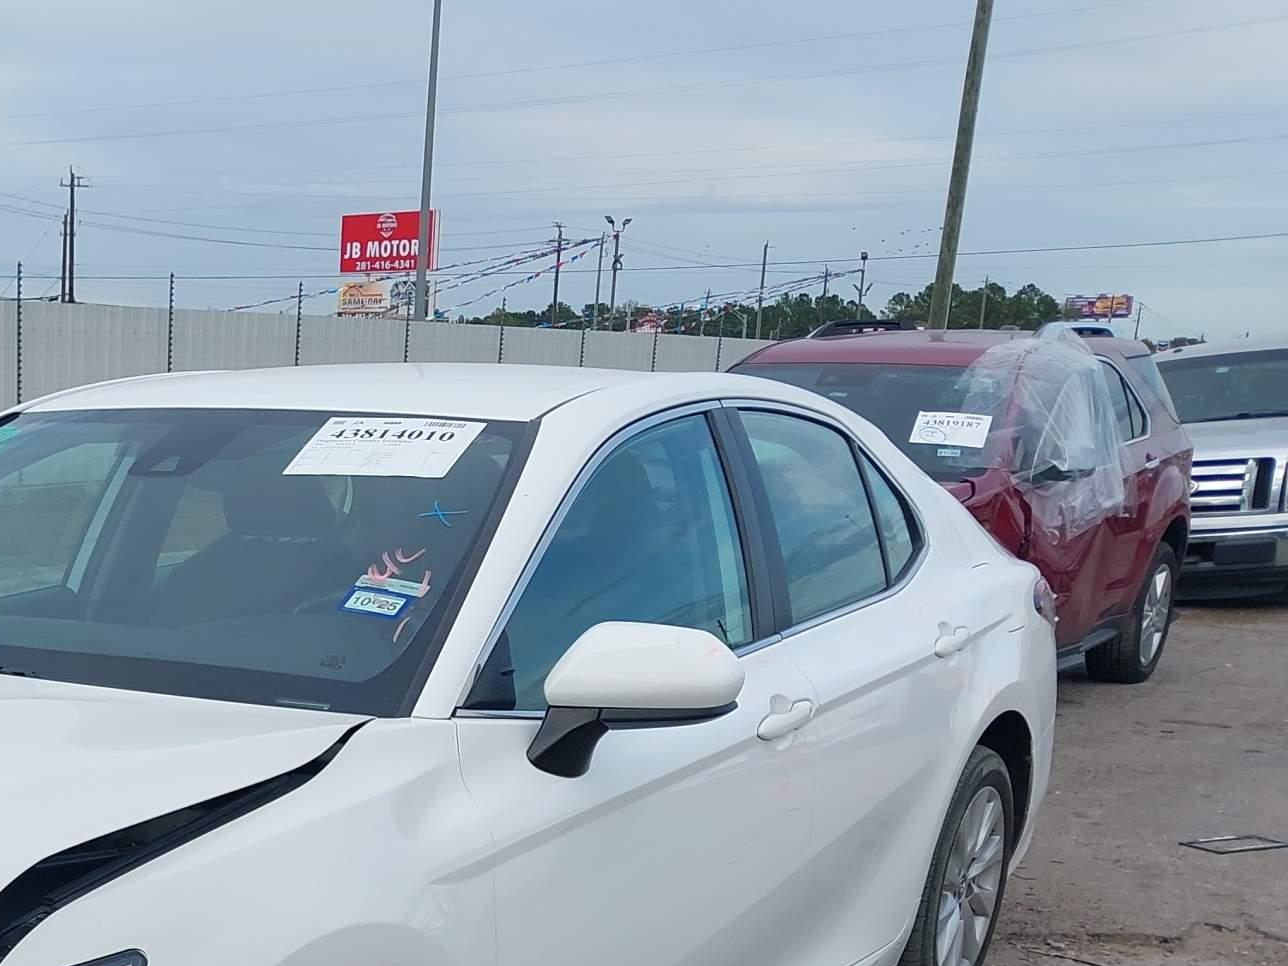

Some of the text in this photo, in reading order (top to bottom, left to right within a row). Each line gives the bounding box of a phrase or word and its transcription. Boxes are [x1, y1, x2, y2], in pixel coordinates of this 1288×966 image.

[344, 240, 428, 259] JB MOTOR
[356, 260, 415, 271] 281-416-4341
[329, 428, 456, 442] 43814010
